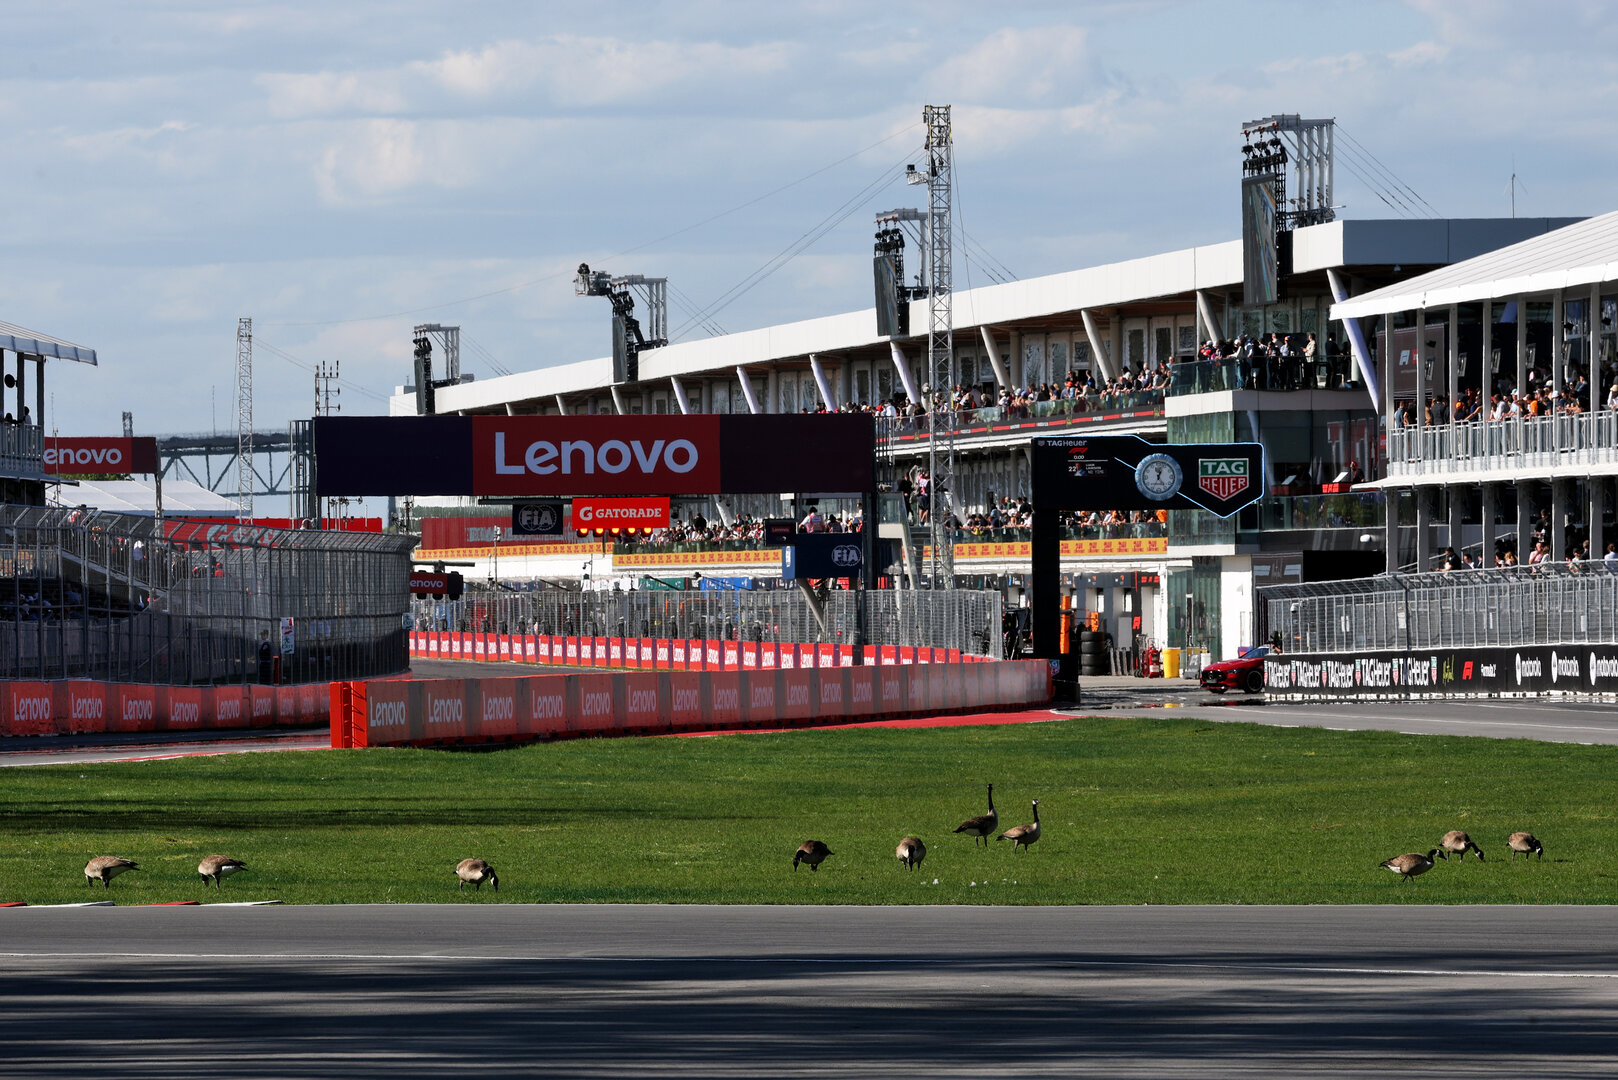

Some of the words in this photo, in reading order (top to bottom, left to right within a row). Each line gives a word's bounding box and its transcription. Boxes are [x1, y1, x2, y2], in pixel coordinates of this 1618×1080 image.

[43, 448, 122, 465] enovo
[495, 431, 698, 475] Lenovo
[1203, 462, 1244, 474] TAG
[1202, 478, 1246, 498] HEUER
[579, 506, 592, 520] G
[596, 508, 661, 518] GATORADE
[410, 580, 443, 588] enovo
[1522, 657, 1541, 677] motorola
[1558, 656, 1579, 676] motorola
[14, 692, 50, 720] Lenovo
[72, 693, 102, 719] Lenovo
[122, 694, 152, 720] Lenovo
[170, 696, 198, 722] Lenovo
[217, 696, 240, 720] Lenovo
[253, 695, 271, 716] Lenovo
[370, 696, 406, 727] Lenovo
[428, 693, 462, 723] Lenovo
[482, 692, 513, 720] Lenovo
[532, 690, 563, 718] Lenovo
[581, 689, 610, 716] Lenovo
[628, 686, 657, 712] Lenovo
[673, 684, 698, 710] Lenovo
[713, 684, 738, 710] Lenovo
[752, 682, 774, 708] Lenovo
[787, 680, 808, 706] Lenovo
[821, 678, 842, 703] Lenovo
[853, 677, 872, 702] Lenovo
